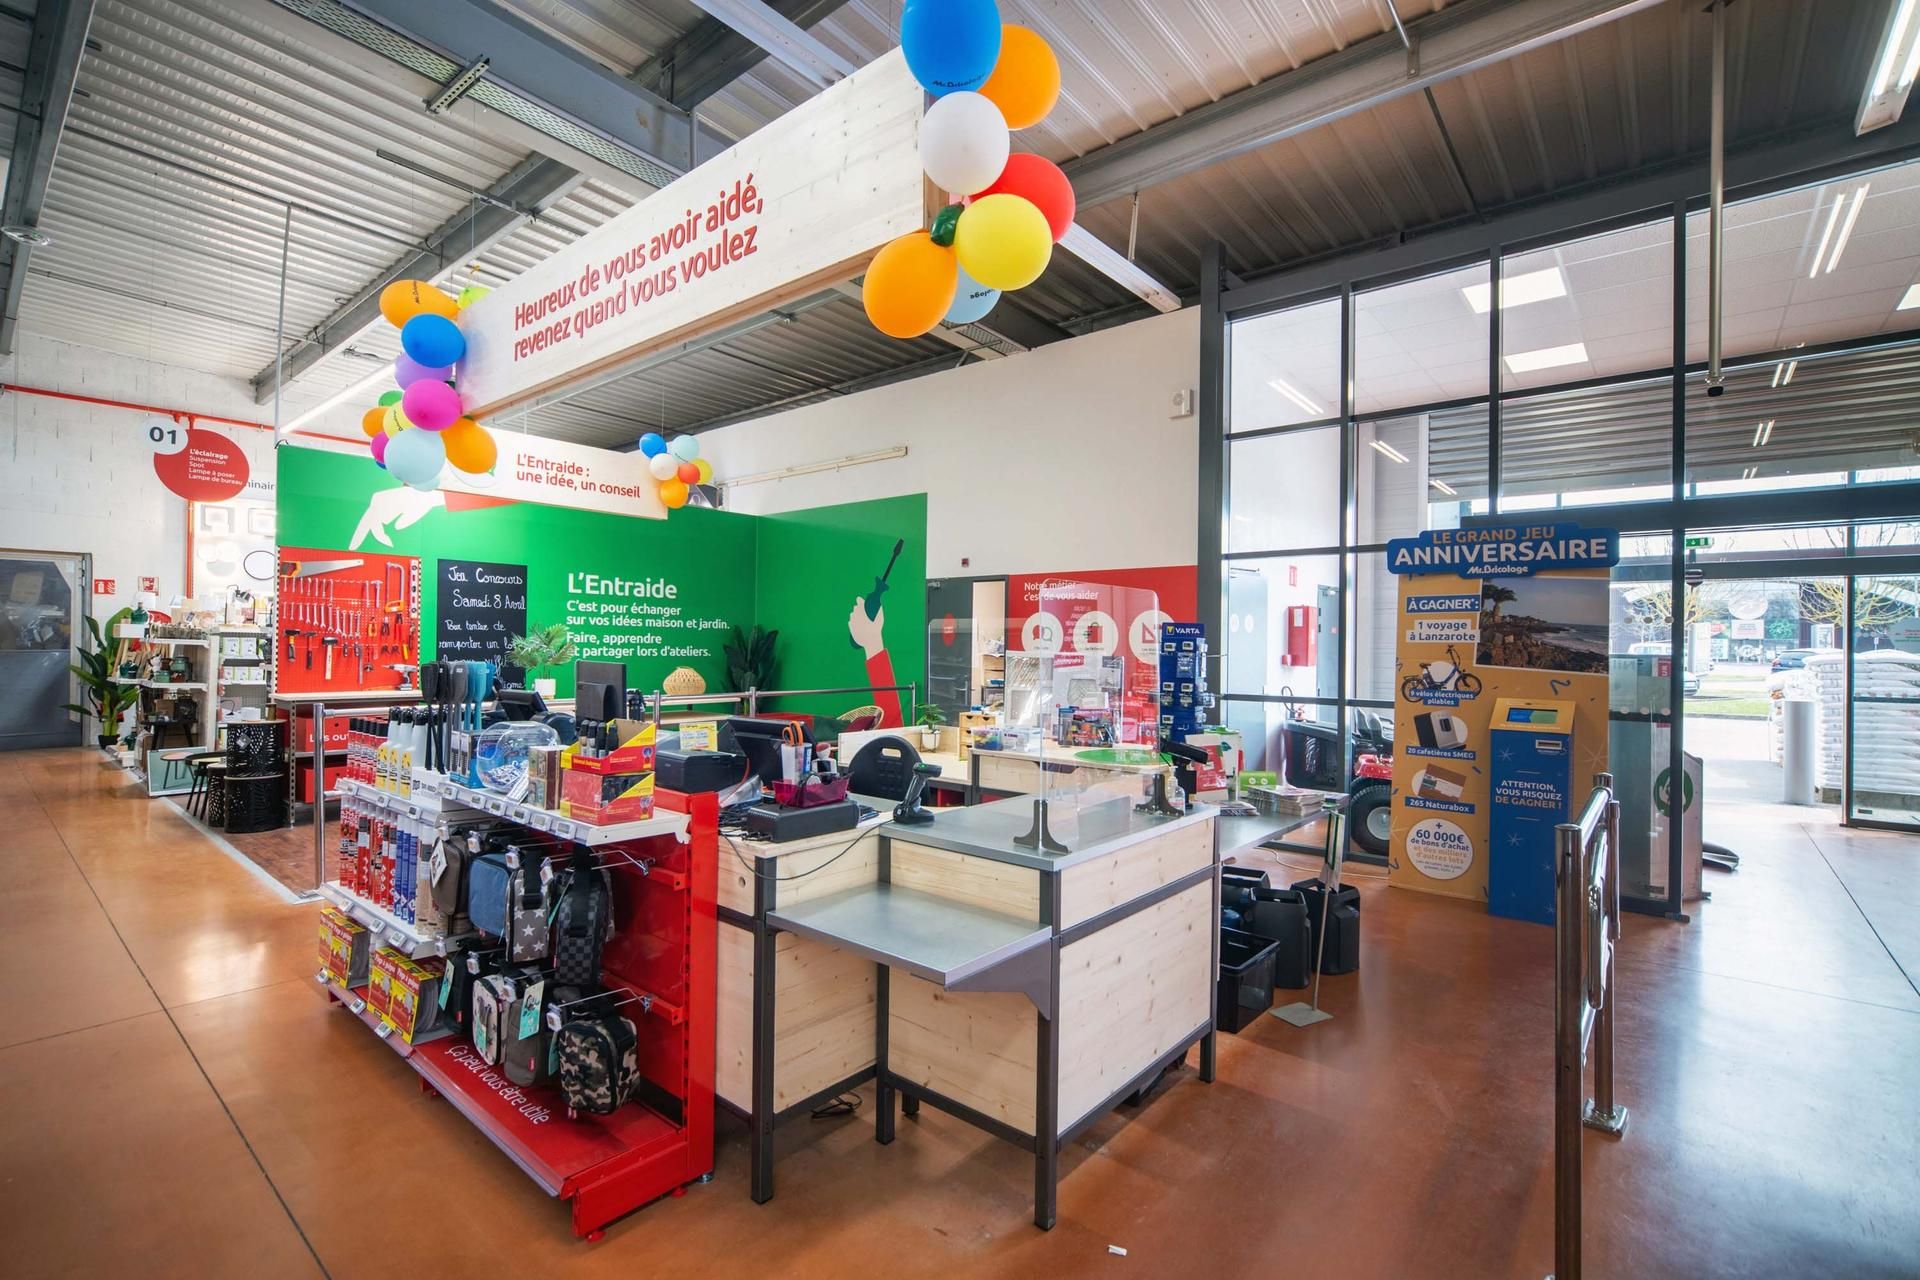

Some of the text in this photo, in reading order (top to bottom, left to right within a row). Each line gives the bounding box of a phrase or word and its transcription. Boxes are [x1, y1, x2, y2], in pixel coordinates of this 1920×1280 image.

[514, 172, 764, 330] Heureux de vous avoir aidé,
[513, 224, 758, 362] revenez quand vous voulez
[149, 426, 177, 445] 01
[189, 449, 228, 460] L'éclairage
[189, 455, 226, 466] Suspension
[517, 453, 584, 477] L'Entraide
[221, 477, 243, 486] bureau
[516, 471, 641, 499] une idée, un conseil
[1433, 526, 1555, 545] LE GRAND JEU
[1394, 538, 1608, 566] ANNIVERSAIRE
[568, 572, 678, 599] L'Entraide
[1024, 580, 1077, 591] Notre métier
[453, 588, 526, 610] Samedi 8 Avril
[1024, 590, 1099, 602] c'est de vous aider
[566, 600, 682, 617] C'est pour échanger
[1408, 598, 1418, 611] À
[493, 620, 507, 631] de
[566, 615, 730, 631] sur vos idées maison et jardin.
[1418, 621, 1468, 632] 1 voyage
[566, 631, 662, 646] Faire, apprendre
[1409, 631, 1476, 641] à Lanzarote
[438, 635, 482, 651] remporter
[486, 640, 500, 649] un
[582, 646, 635, 658] partager
[637, 646, 658, 657] lors
[660, 646, 712, 657] d'ateliers.
[1416, 689, 1433, 697] vélos
[1434, 690, 1474, 700] électriques
[1427, 697, 1455, 705] pliables
[309, 734, 330, 742] Ls
[1417, 748, 1451, 757] cafetières
[1453, 750, 1474, 759] SMEG
[1501, 780, 1556, 792] ATTENTION,
[1495, 788, 1562, 801] VOUS RISQUEZ
[1410, 799, 1470, 812] 265 Naturabox
[1495, 796, 1509, 804] DE
[1511, 797, 1556, 809] GAGNER
[1416, 829, 1465, 844] 60 000€
[1421, 839, 1440, 847] bons
[1441, 842, 1470, 851] d'achat
[444, 1044, 552, 1125] Ça peut vous être utile
